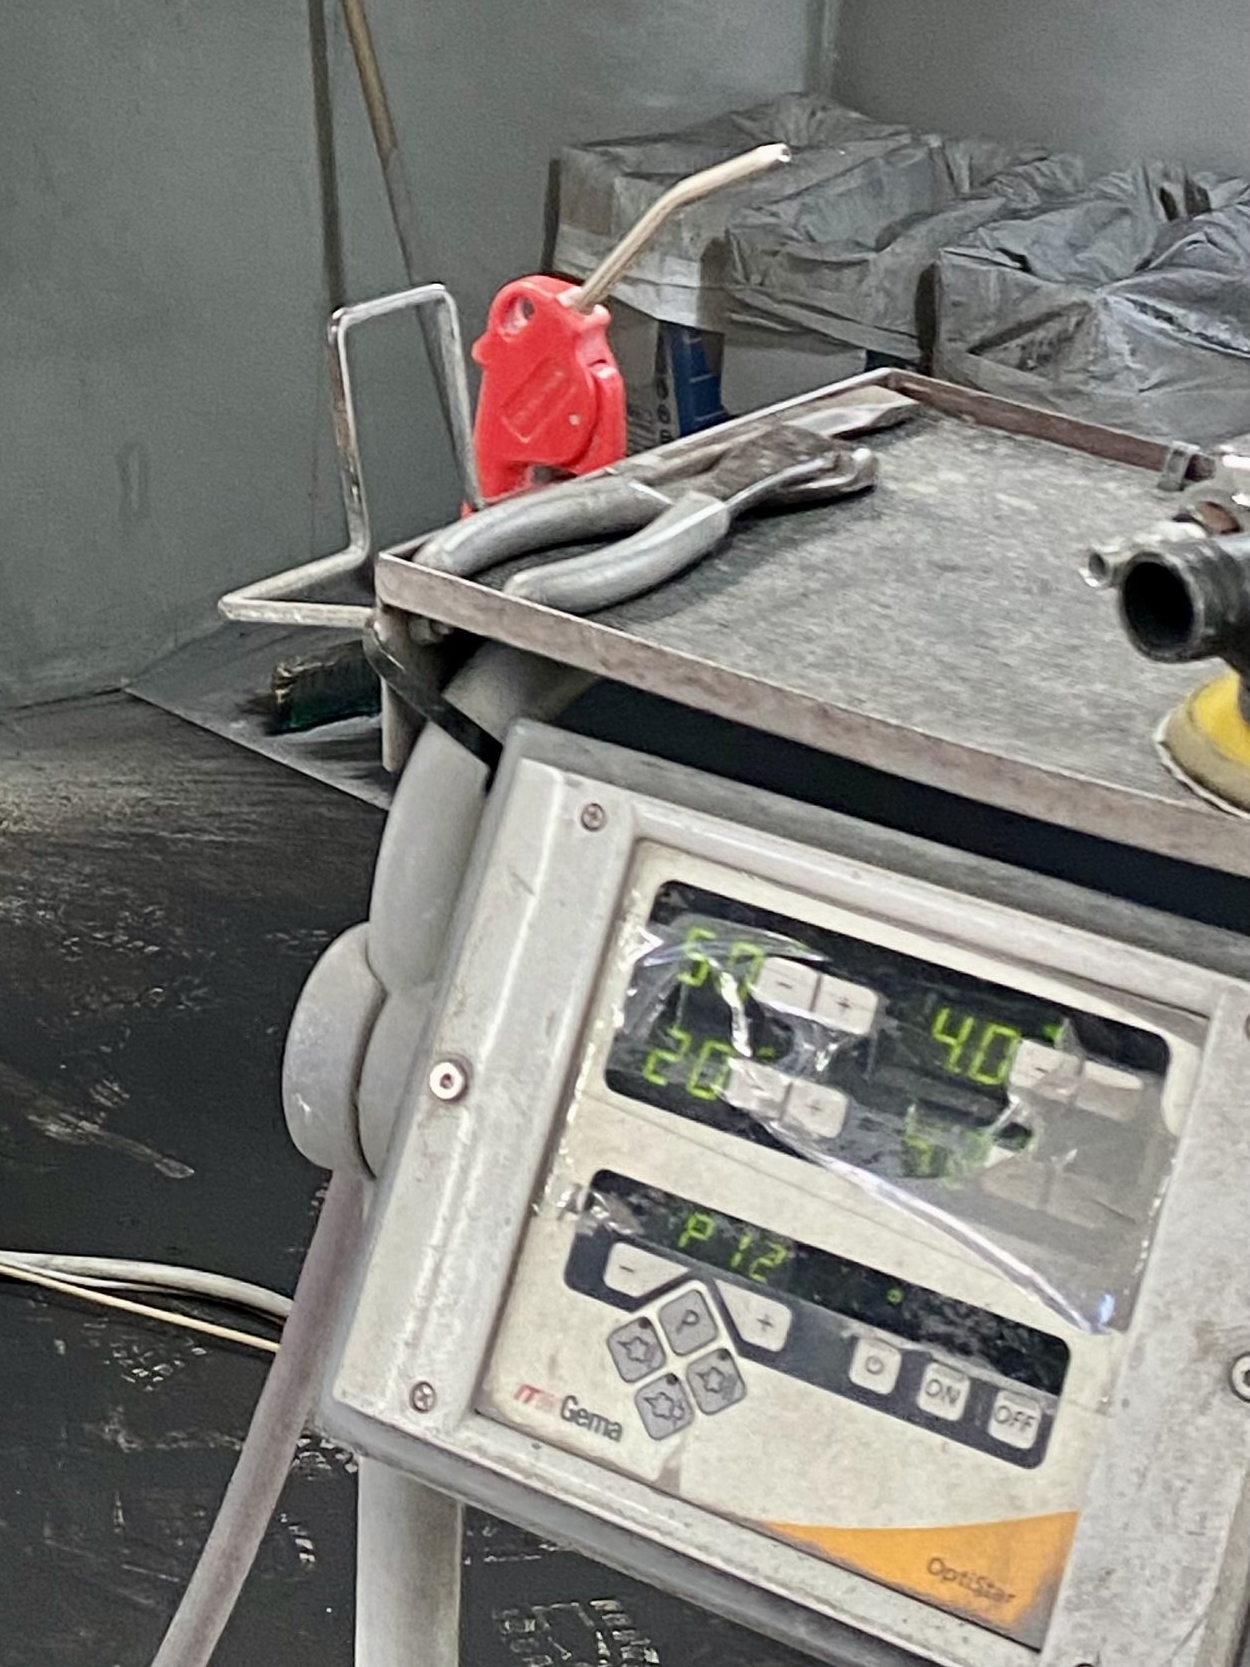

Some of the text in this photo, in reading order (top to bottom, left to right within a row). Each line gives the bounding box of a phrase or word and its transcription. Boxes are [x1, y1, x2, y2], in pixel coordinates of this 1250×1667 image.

[642, 1026, 737, 1101] 20
[931, 1007, 1022, 1085] 40
[924, 1378, 961, 1405] ON
[560, 1394, 623, 1442] Gema
[993, 1404, 1036, 1433] OFF
[927, 1556, 1017, 1603] OptiStar
